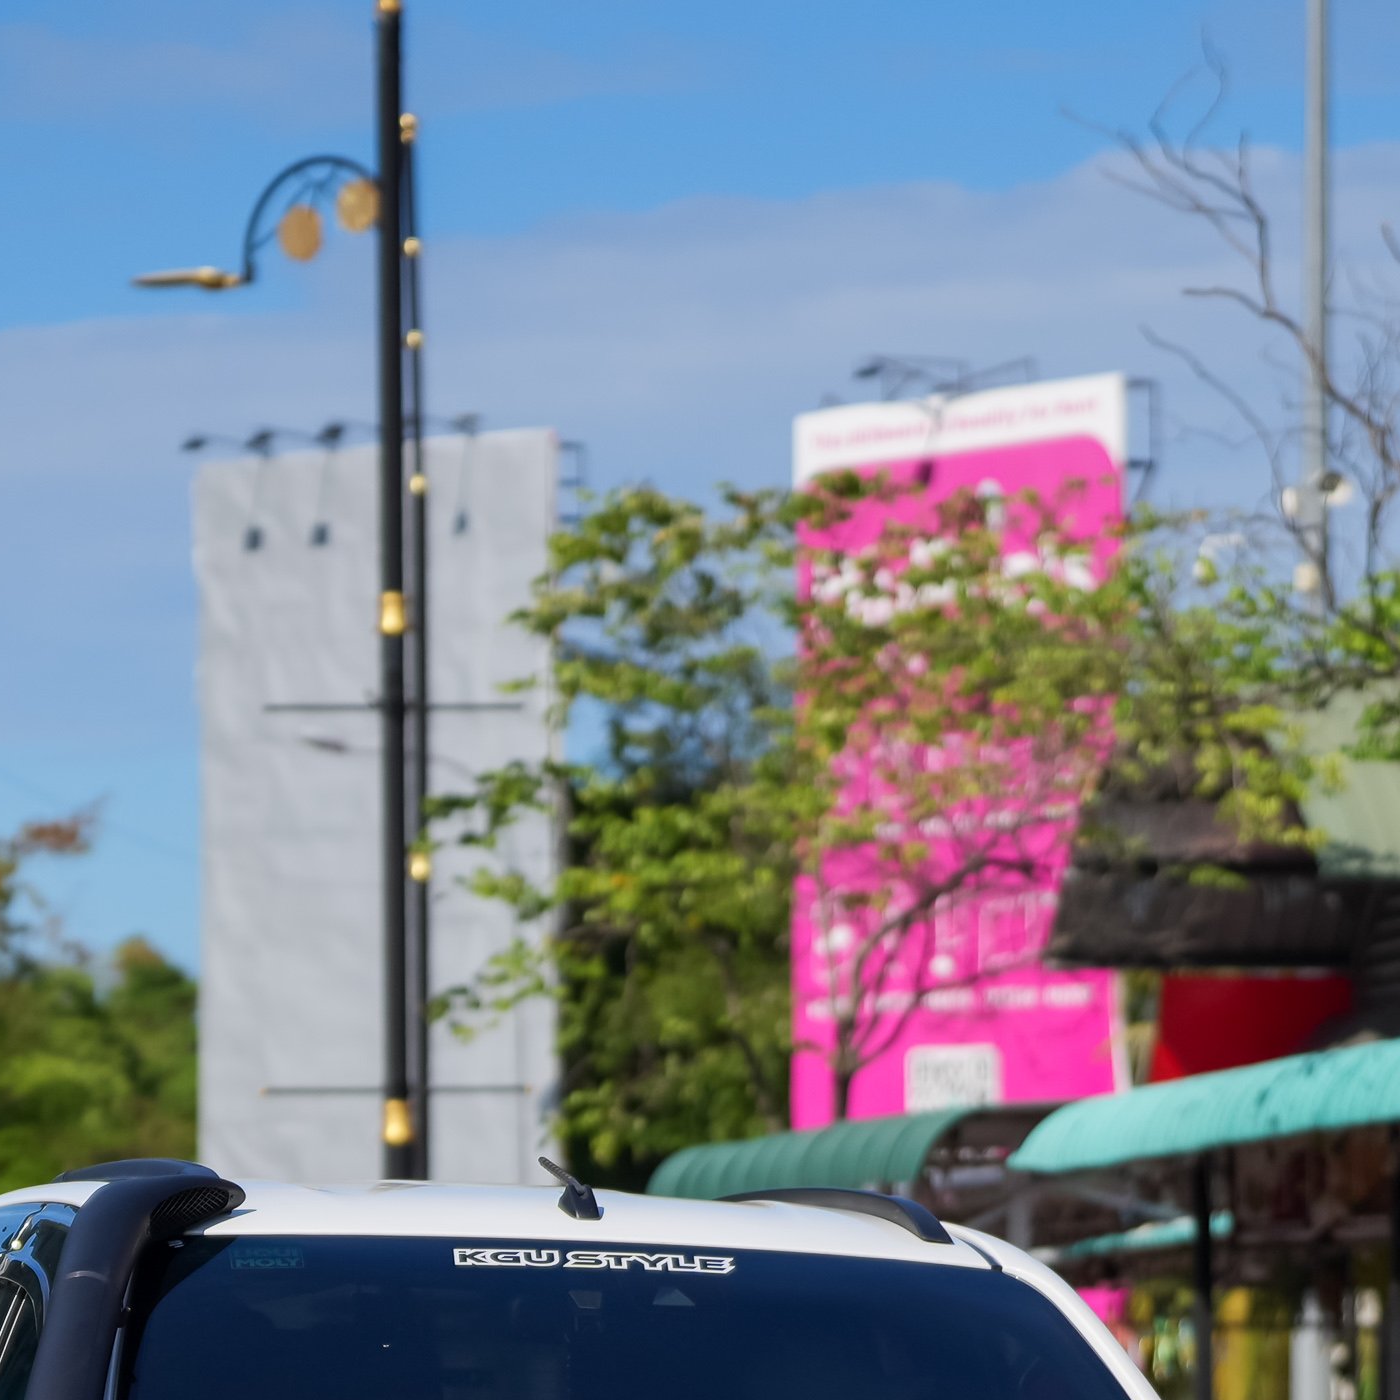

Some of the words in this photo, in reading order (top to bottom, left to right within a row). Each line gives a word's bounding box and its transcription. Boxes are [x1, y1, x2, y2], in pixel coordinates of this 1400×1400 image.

[235, 1258, 300, 1267] MOLY
[453, 1248, 560, 1267] KGU
[562, 1250, 736, 1274] STYLE
